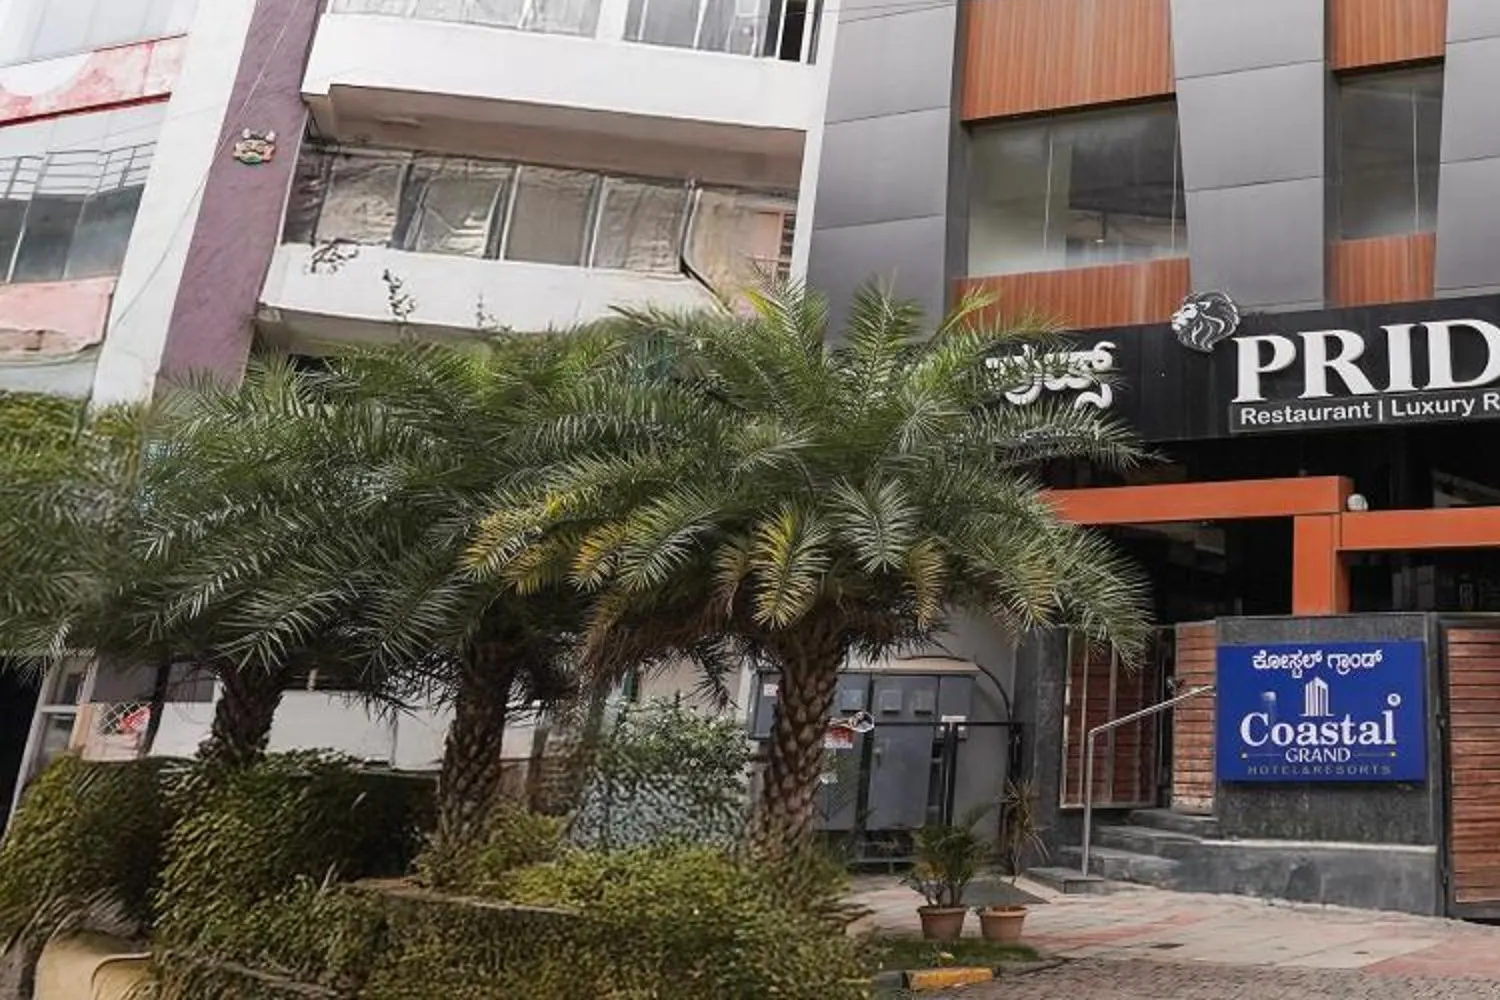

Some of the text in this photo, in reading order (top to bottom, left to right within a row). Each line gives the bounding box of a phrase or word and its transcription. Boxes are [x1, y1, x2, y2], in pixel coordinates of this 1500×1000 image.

[1240, 401, 1372, 426] Restaurant
[1391, 395, 1475, 421] Luxury
[1240, 709, 1397, 747] Coastal
[1285, 747, 1351, 763] GRAND
